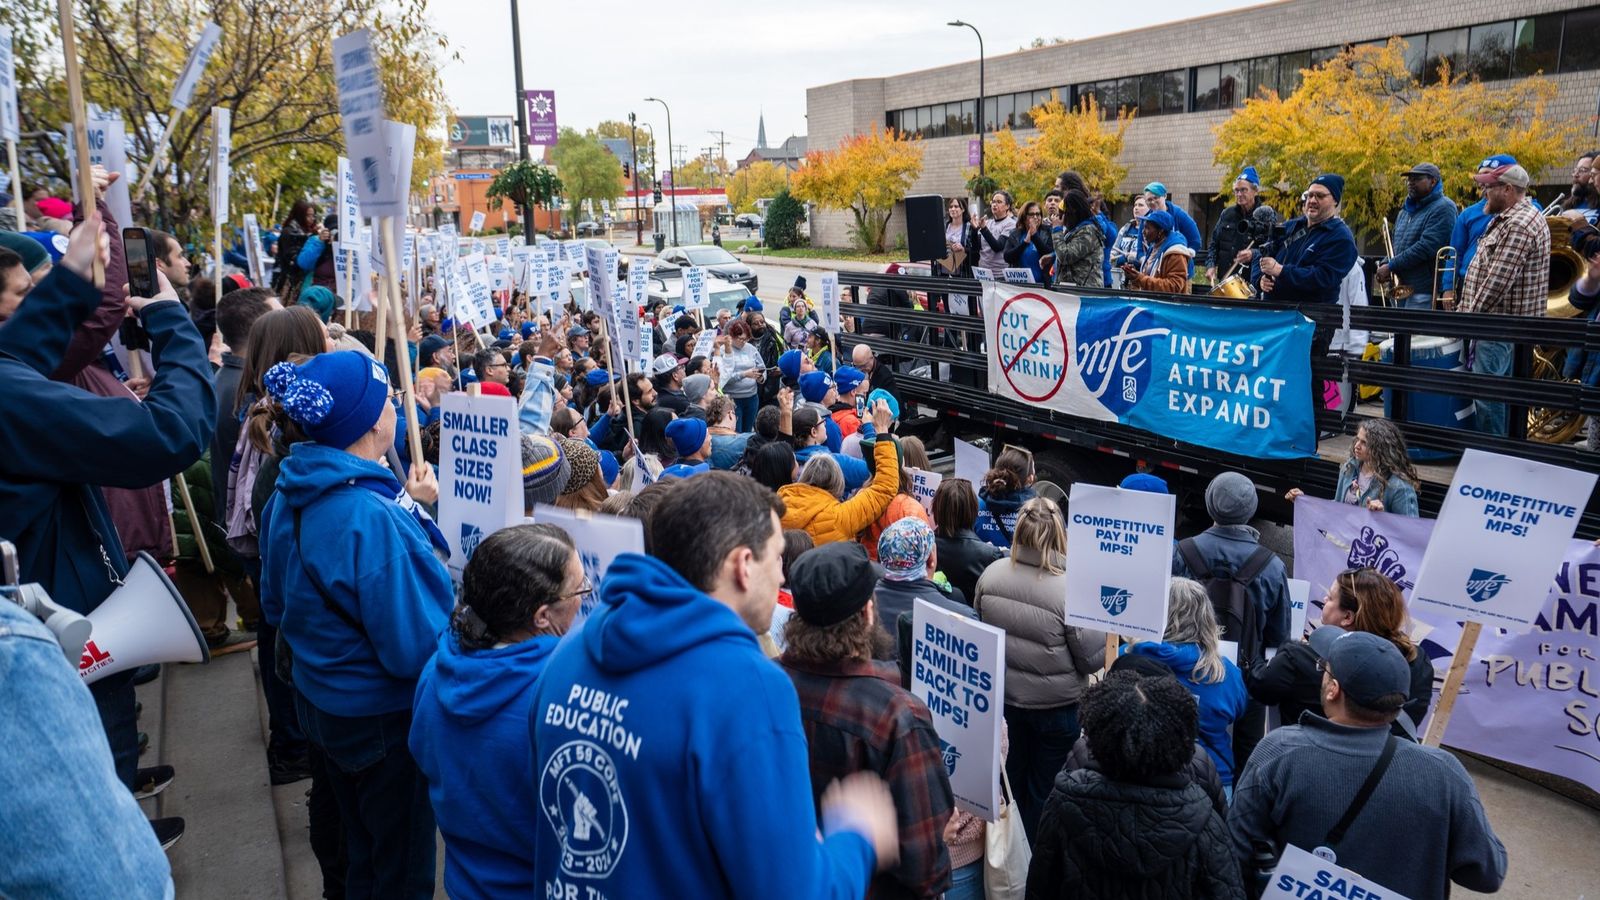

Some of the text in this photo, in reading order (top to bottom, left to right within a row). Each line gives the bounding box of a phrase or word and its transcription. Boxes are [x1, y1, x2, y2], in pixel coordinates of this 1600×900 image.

[1001, 312, 1029, 329] CUT
[1002, 333, 1050, 357] CLOSE
[1170, 334, 1264, 367] INVEST
[1003, 354, 1063, 380] SHRINK
[1168, 362, 1286, 402] ATTRACT
[1168, 390, 1270, 429] EXPAND
[443, 411, 509, 436] SMALLER
[452, 435, 497, 458] CLASS
[455, 458, 493, 481] SIZES
[454, 480, 492, 504] NOW!
[1459, 484, 1577, 518] COMPETITIVE
[1073, 514, 1164, 536] COMPETITIVE
[1484, 504, 1540, 526] PAY IN
[1485, 518, 1529, 537] MPS!
[1096, 529, 1139, 544] PAY IN
[1100, 542, 1133, 556] MPS!
[925, 622, 978, 662] BRING
[1538, 643, 1596, 661] FOR
[88, 658, 114, 673] CITIES
[915, 639, 992, 692] FAMILIES
[1481, 654, 1599, 698] PUBL
[915, 661, 989, 713] BACK TO
[568, 684, 629, 723] PUBLIC
[928, 691, 968, 729] MPS!
[545, 703, 642, 761] EDUCATION
[549, 748, 572, 779] MFT
[576, 745, 592, 763] 59
